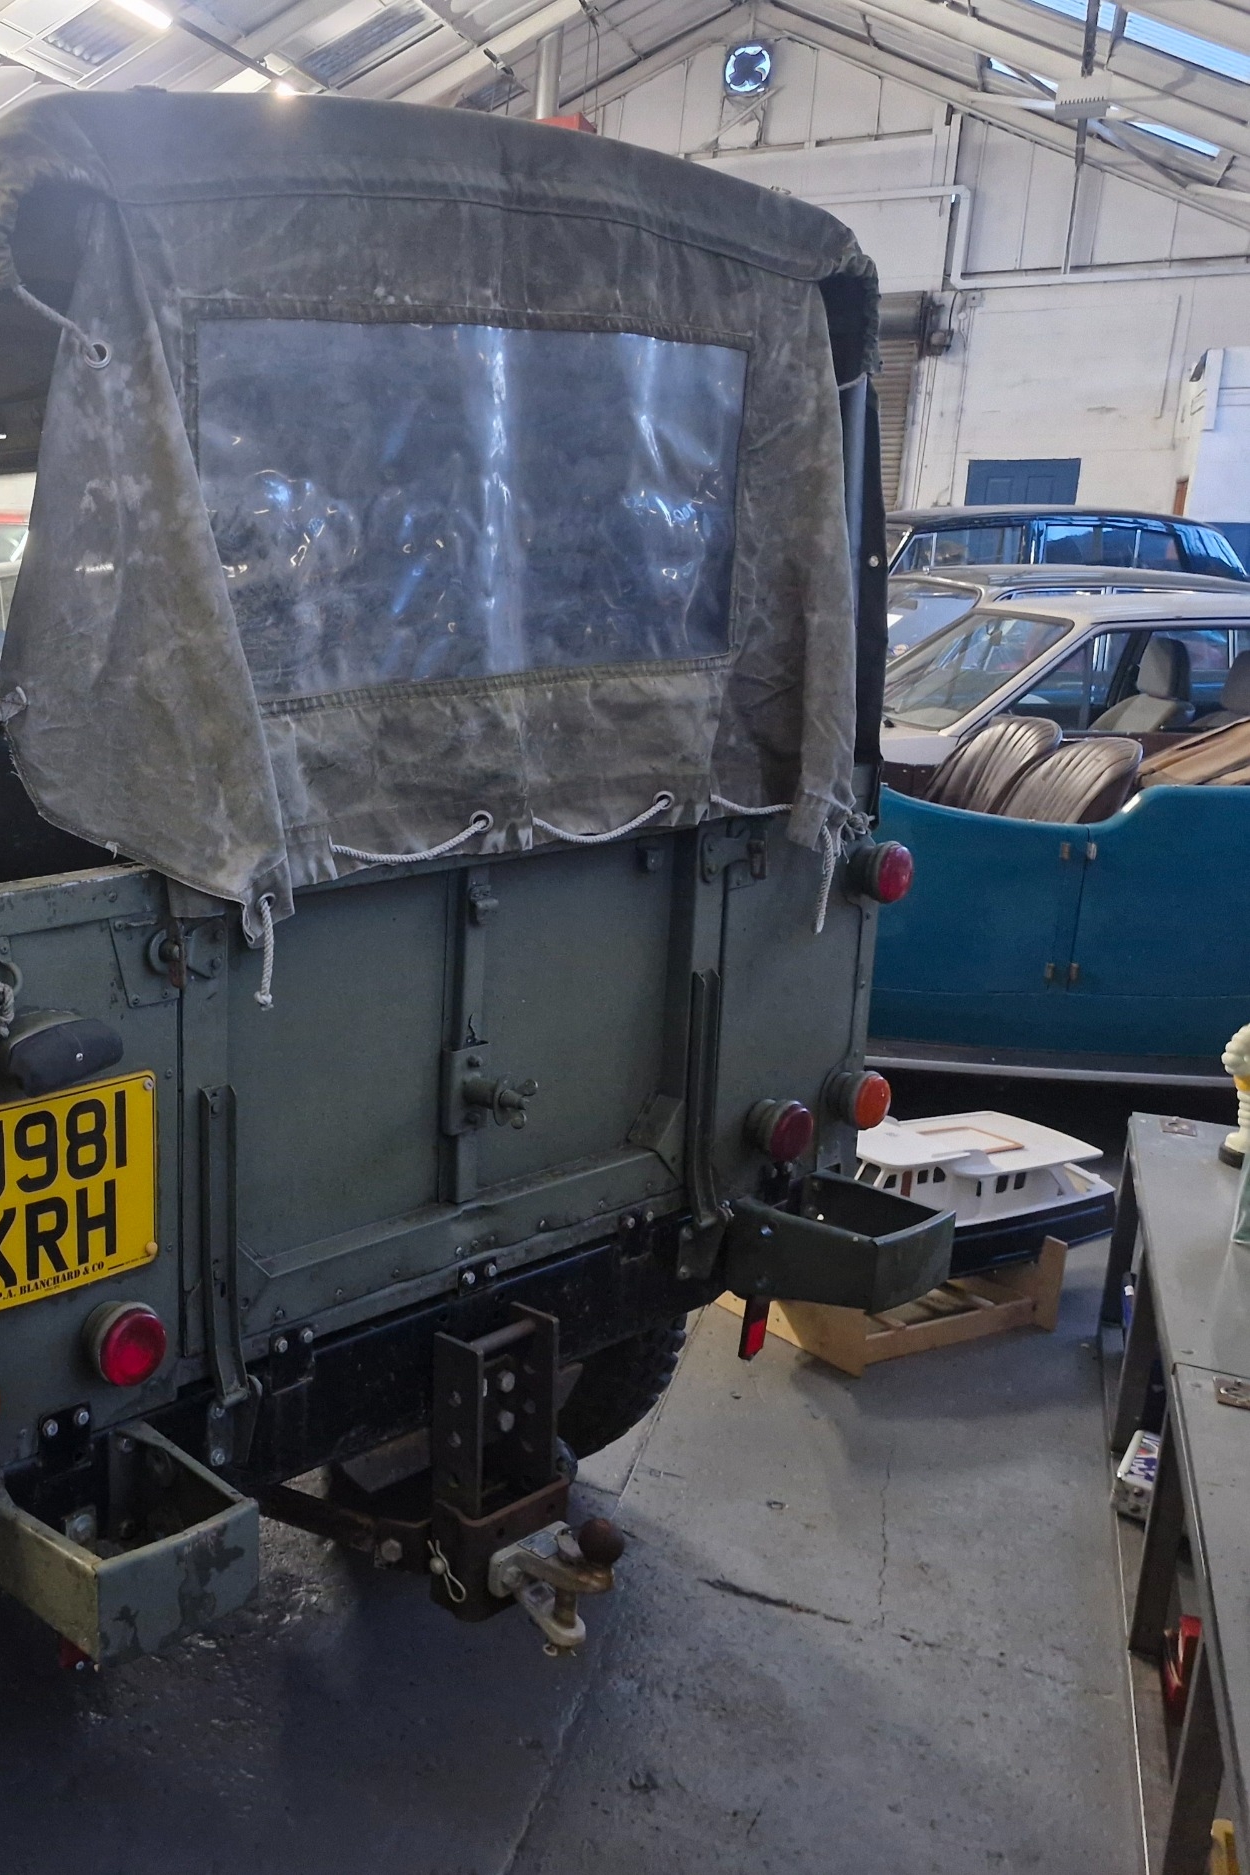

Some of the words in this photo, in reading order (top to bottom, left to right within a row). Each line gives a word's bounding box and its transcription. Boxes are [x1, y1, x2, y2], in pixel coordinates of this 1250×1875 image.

[20, 1270, 81, 1294] BLANCHARD
[82, 1266, 90, 1276] &
[92, 1261, 104, 1272] CO
